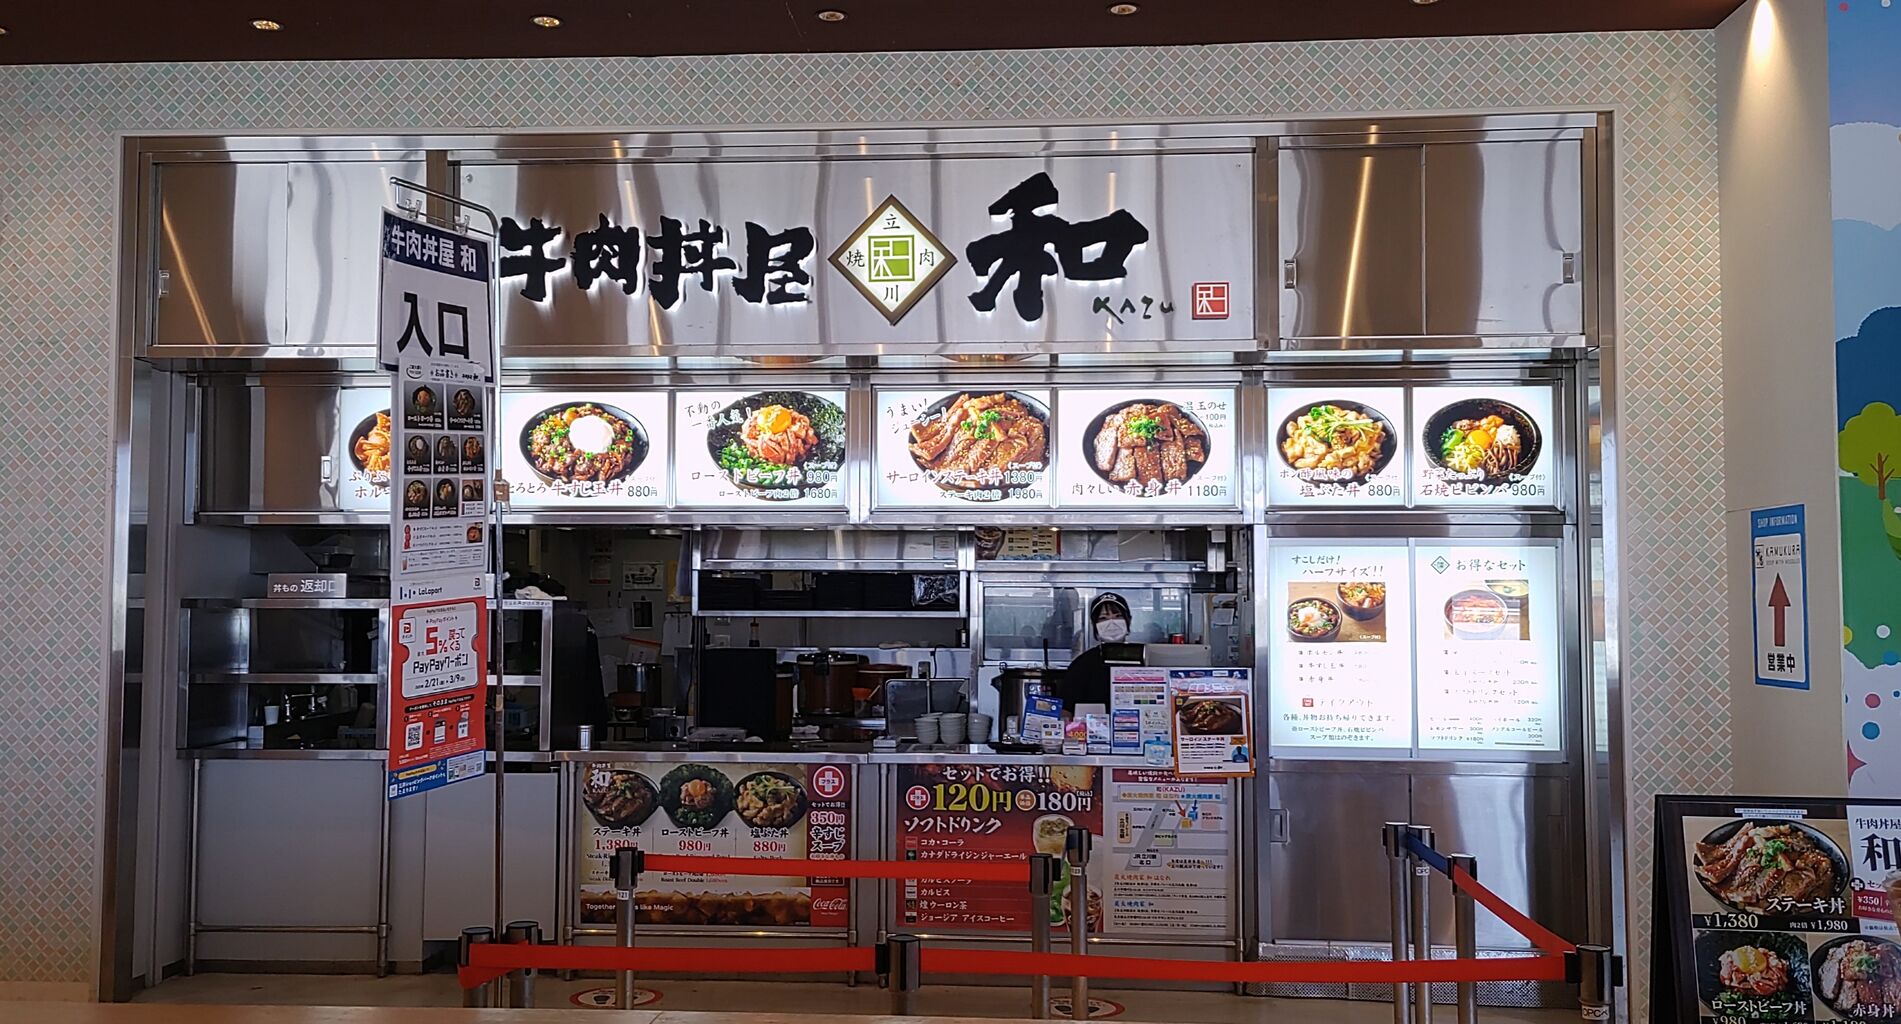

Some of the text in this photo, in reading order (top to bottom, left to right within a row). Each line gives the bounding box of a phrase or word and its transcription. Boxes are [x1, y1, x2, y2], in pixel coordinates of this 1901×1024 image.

[882, 214, 900, 230] 立
[391, 225, 477, 272] 牛肉丼屋 和
[966, 172, 1149, 322] 和
[499, 213, 817, 309] 牛肉丼屋
[846, 250, 865, 267] 焼
[919, 249, 935, 266] 肉
[884, 285, 899, 302] 川
[1092, 296, 1176, 324] KAZU
[397, 291, 471, 360] 入口
[349, 470, 391, 482] ぷりぷ
[691, 469, 802, 485] ローストビーフ丼
[886, 469, 1003, 485] サーロインステーキ丼
[1072, 482, 1116, 496] 肉々しい
[1125, 480, 1182, 496] 赤身丼
[1300, 484, 1361, 498] 塩ぶた丼
[1765, 544, 1801, 557] KAMUKURA
[1456, 559, 1526, 571] お得なセット
[300, 579, 337, 593] 返却口
[412, 653, 469, 674] PayPayクーポン
[1767, 652, 1796, 673] 営業中
[590, 769, 612, 789] 和
[942, 765, 1051, 784] セットでお得!!
[932, 783, 1012, 812] 120円
[1037, 791, 1092, 812] 180円
[810, 811, 846, 825] 350円
[904, 815, 1002, 835] ソフトドリンク
[1855, 818, 1901, 830] 牛肉丼屋
[593, 827, 789, 838] ステーキ丼 ローストビーフ丼 塩ぶた丼
[678, 840, 711, 851] 980円
[753, 841, 786, 852] 880円
[810, 839, 846, 853] スープ
[920, 838, 965, 847] コカ・コーラ
[920, 850, 1027, 860] カナダドライジンジャーエール
[1860, 833, 1901, 872] 和
[920, 888, 951, 896] カルピス
[586, 903, 616, 911] Together
[1766, 897, 1847, 915] ステーキ丼
[1857, 895, 1880, 906] ¥350
[920, 913, 1015, 923] ジョージア アイスコーヒー
[1703, 913, 1759, 930] ¥1,380
[1810, 920, 1848, 931] ¥1,980
[1711, 999, 1895, 1018] ローストビーフ丼 赤身丼
